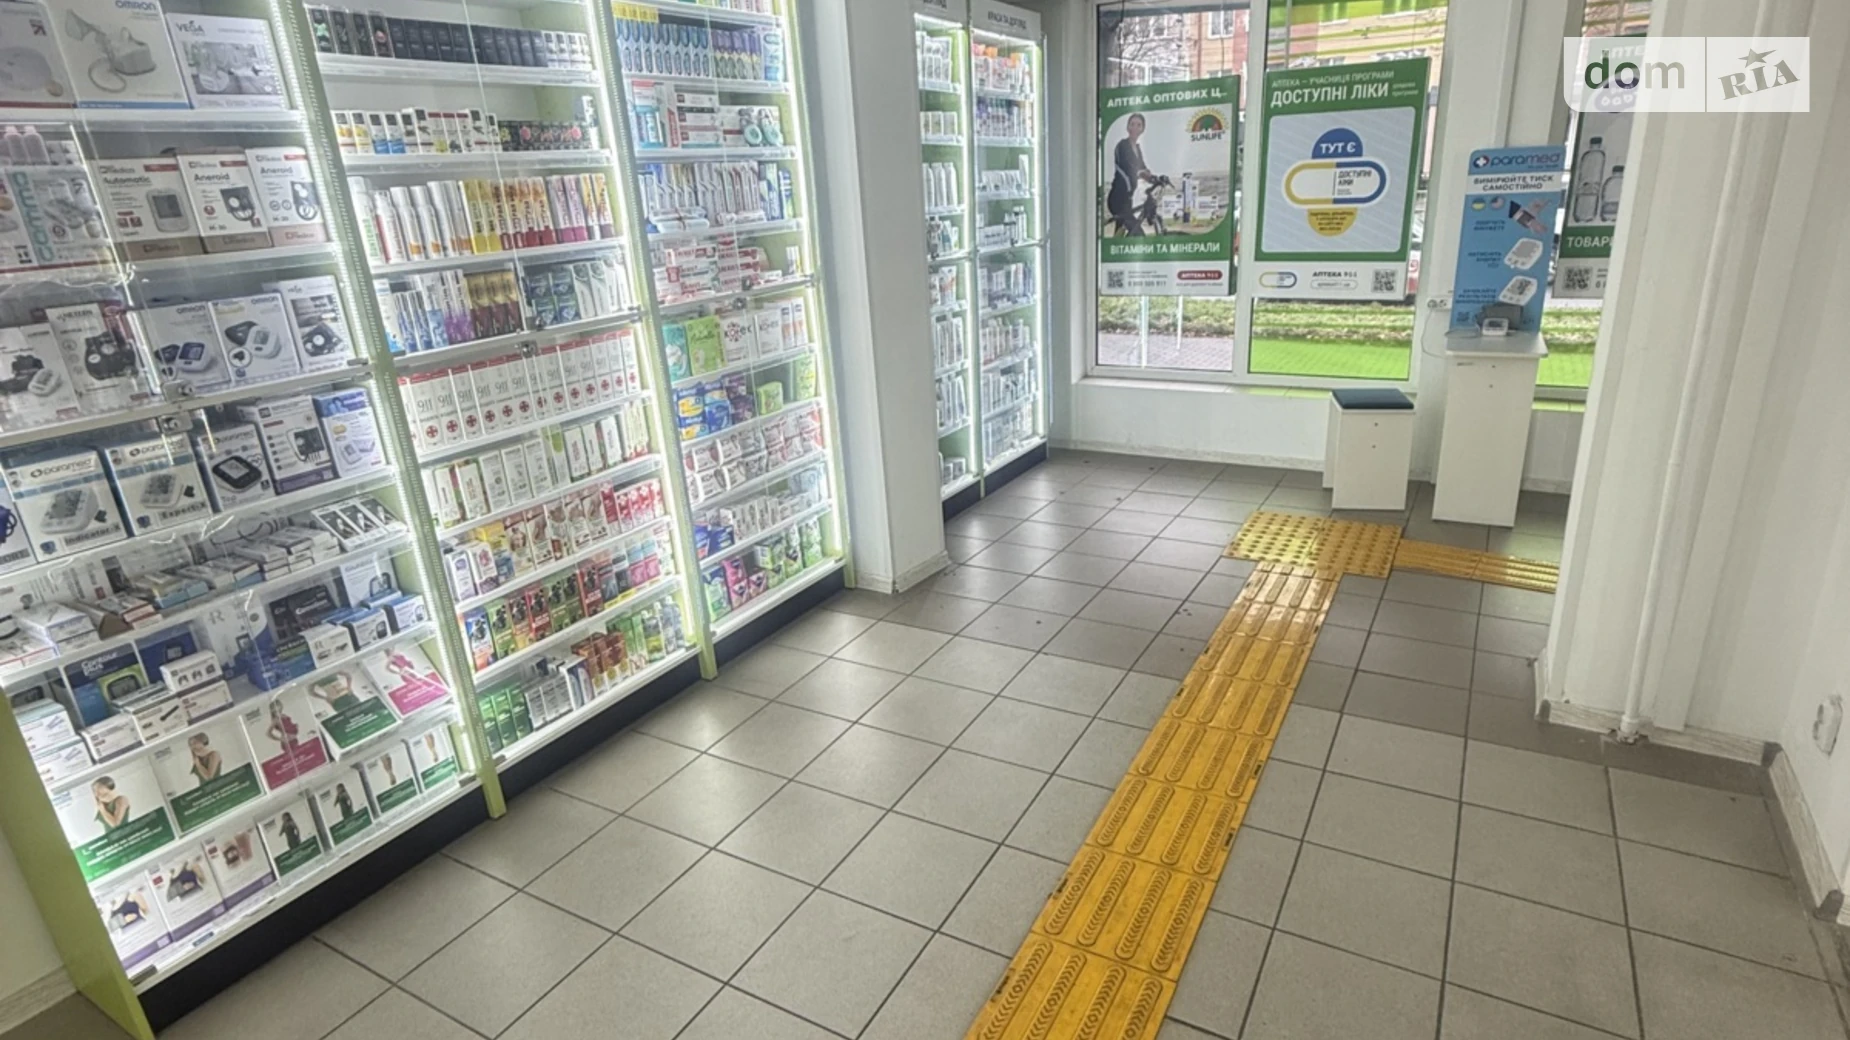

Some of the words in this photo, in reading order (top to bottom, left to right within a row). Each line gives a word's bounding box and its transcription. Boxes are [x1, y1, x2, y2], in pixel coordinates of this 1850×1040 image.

[1272, 79, 1300, 88] АПТЕКА
[1309, 74, 1351, 86] УЧАСНИЦЯ
[1352, 71, 1394, 82] ПРОГРАМИ
[1107, 96, 1150, 108] АПТЕКА
[1153, 88, 1208, 103] ОПТОВИХ
[1270, 85, 1346, 108] ДОСТУПНІ
[1350, 82, 1389, 100] ЛІКИ
[1191, 132, 1222, 142] SUNLIFE
[1320, 142, 1344, 154] ТУТ
[1346, 142, 1356, 153] Є
[1490, 153, 1560, 167] paramed
[260, 167, 294, 175] Aneroid
[194, 173, 230, 182] Aneroid
[1474, 175, 1527, 184] ВИМІРЮЙТЕ
[1530, 175, 1554, 183] ТИСК
[1483, 183, 1543, 192] САМОСТІЙНО
[1111, 244, 1153, 255] ВІТАМІНИ
[1156, 244, 1168, 253] ТА
[1170, 242, 1220, 253] МІНЕРАЛИ
[42, 458, 93, 474] paramed
